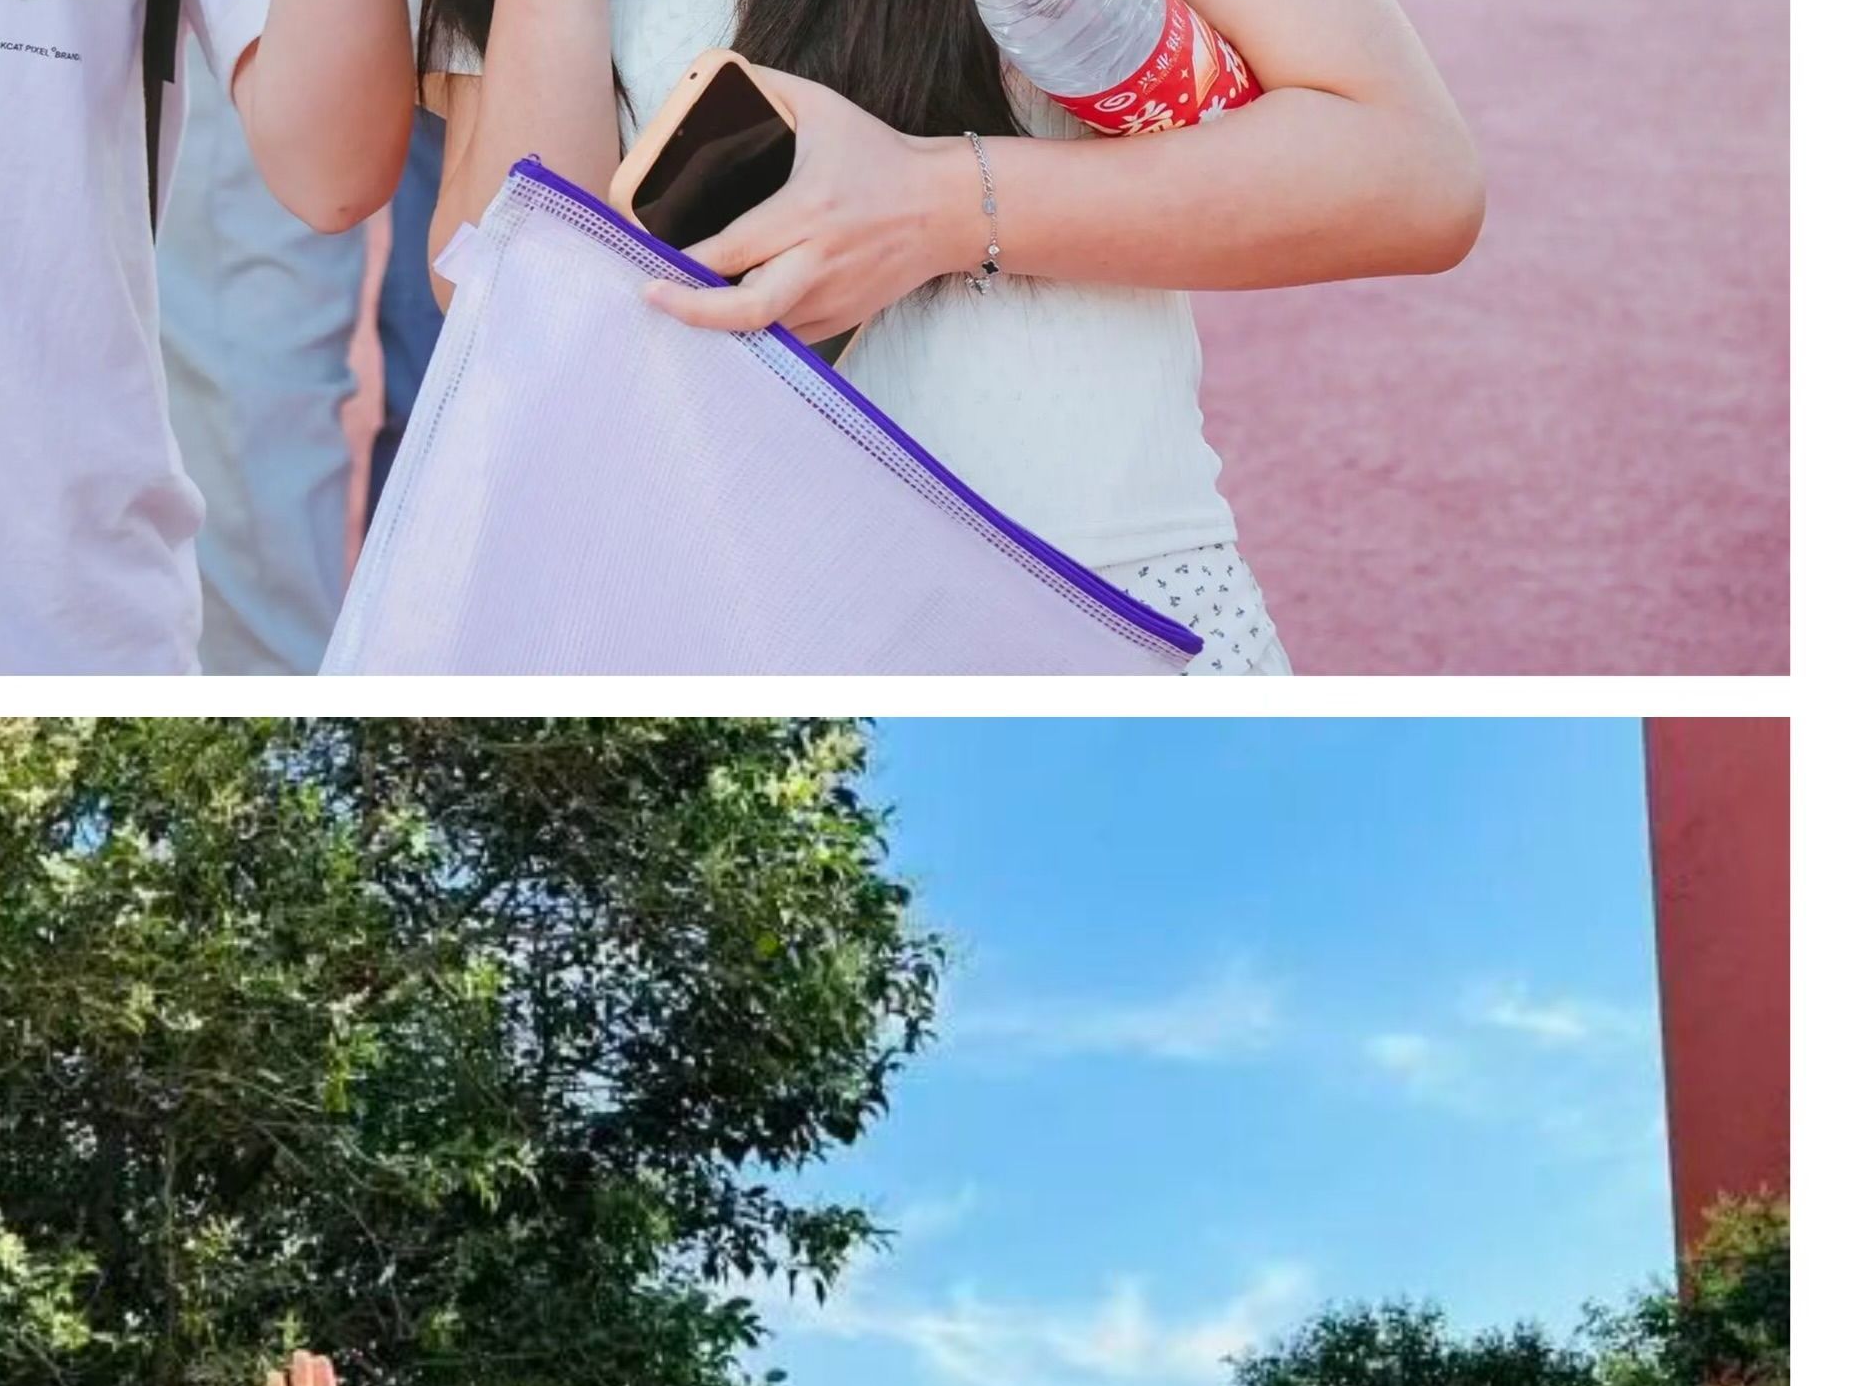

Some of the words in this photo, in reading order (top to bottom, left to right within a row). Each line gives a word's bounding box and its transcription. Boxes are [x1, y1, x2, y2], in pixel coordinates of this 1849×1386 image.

[24, 44, 50, 58] PIXEL
[1137, 9, 1184, 92] 兴业银行
